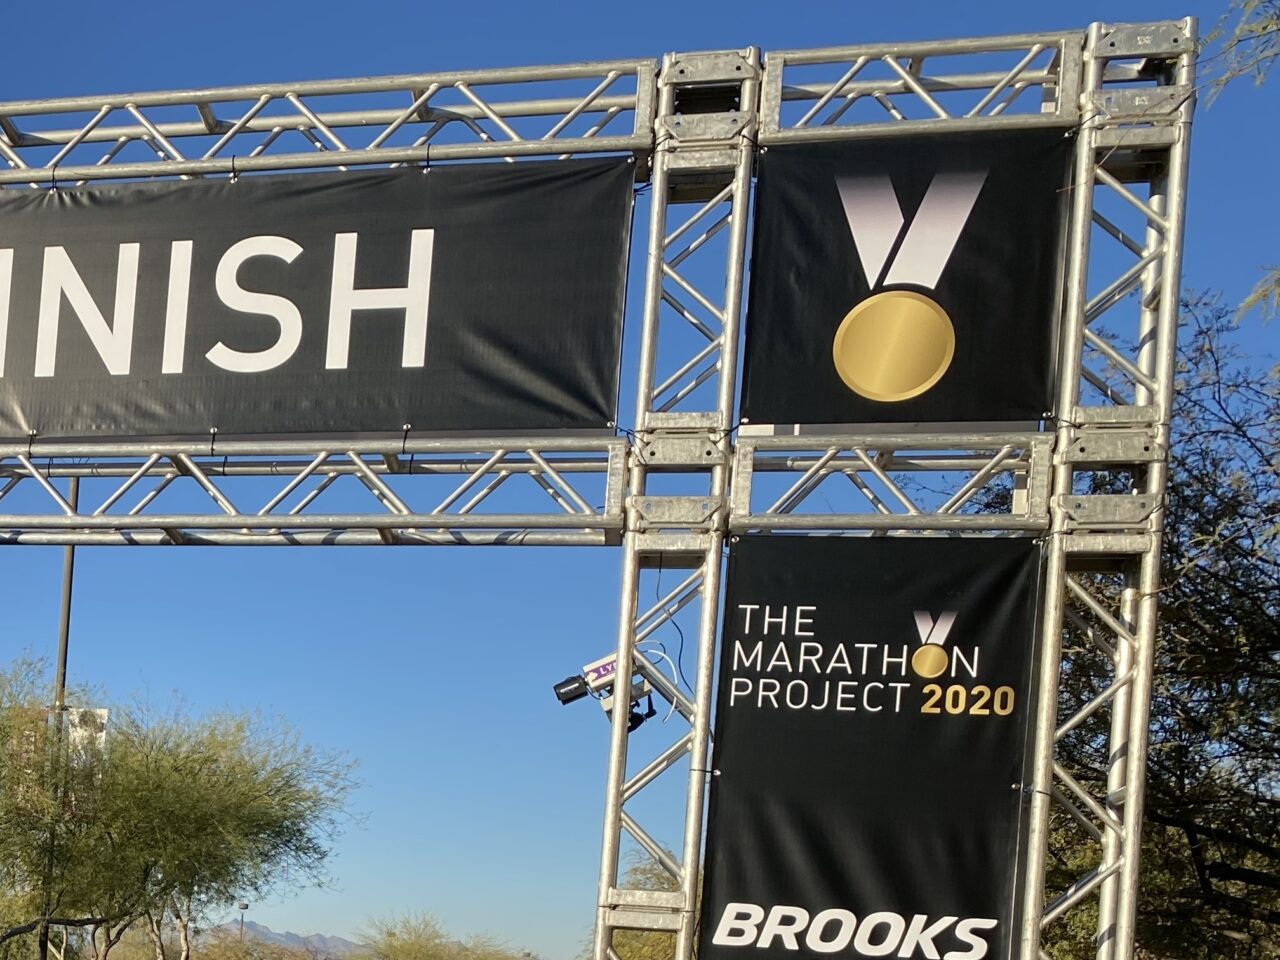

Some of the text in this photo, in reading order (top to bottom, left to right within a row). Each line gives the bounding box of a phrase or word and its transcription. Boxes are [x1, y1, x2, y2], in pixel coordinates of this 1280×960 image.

[738, 604, 817, 636] THE
[732, 640, 980, 678] MARATHON
[729, 677, 1015, 716] PROJECT 2020
